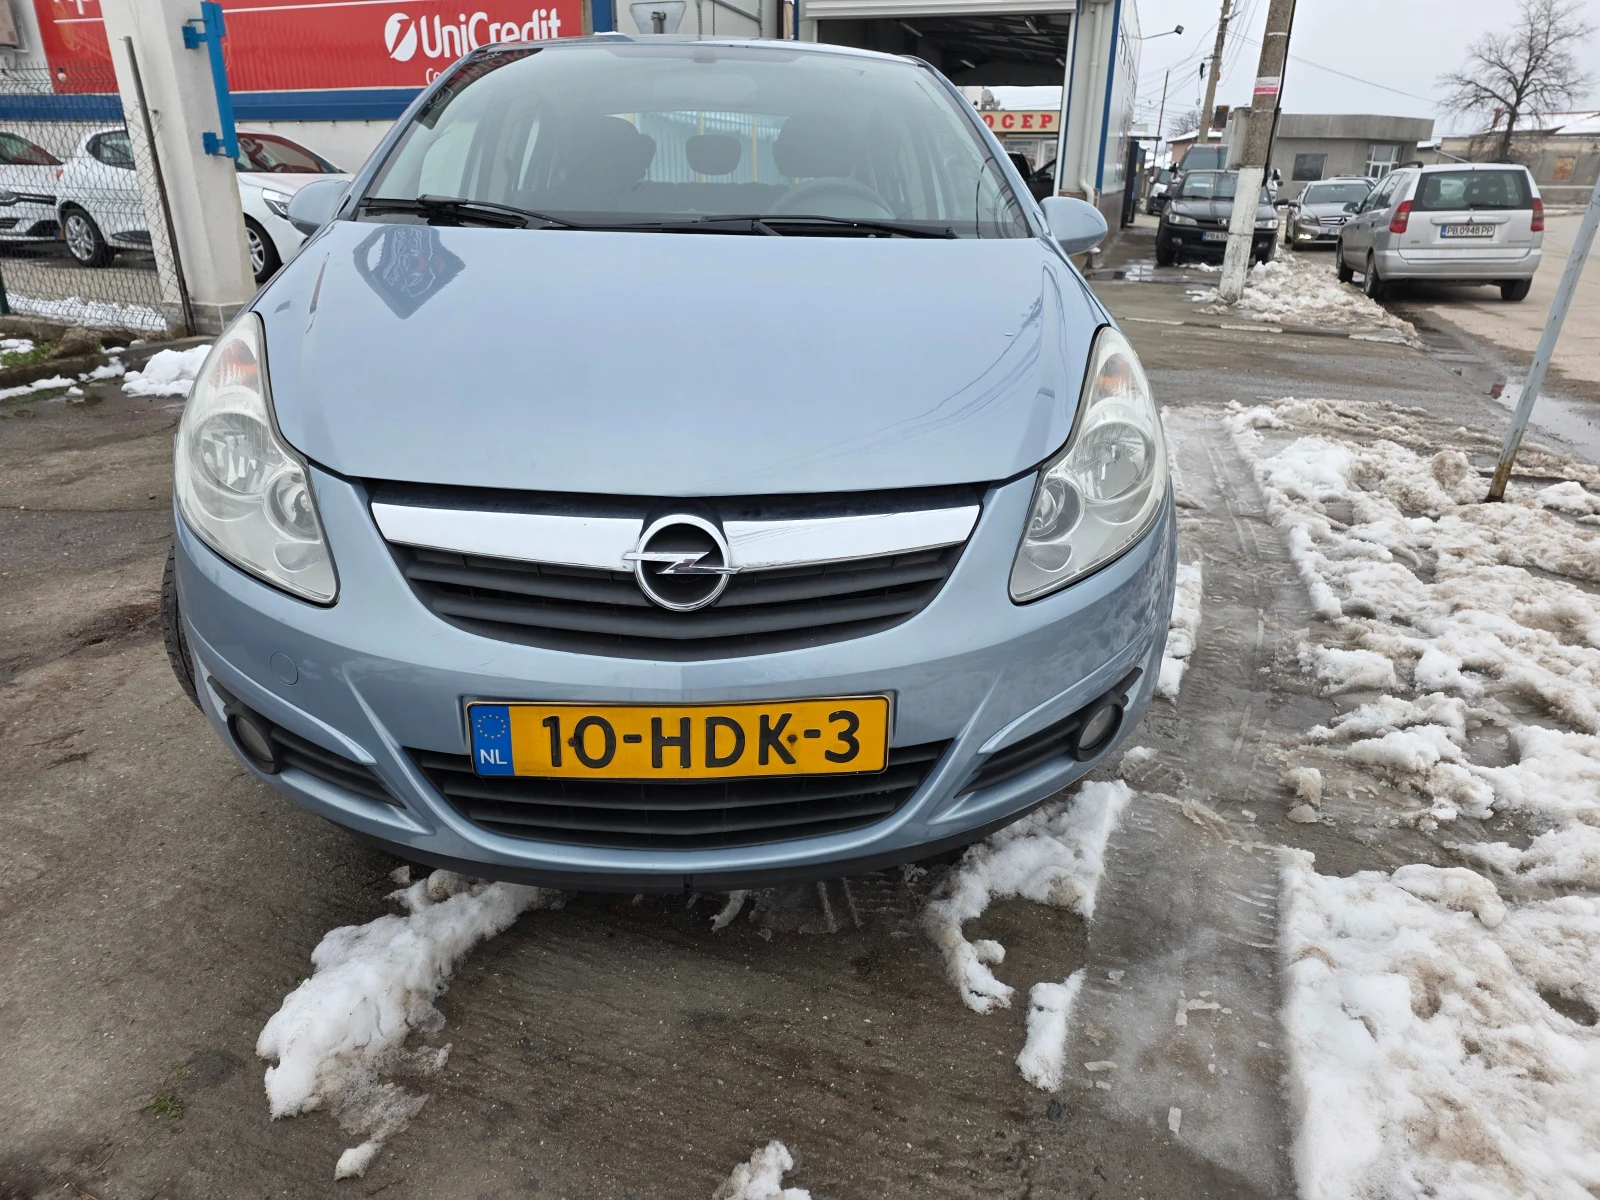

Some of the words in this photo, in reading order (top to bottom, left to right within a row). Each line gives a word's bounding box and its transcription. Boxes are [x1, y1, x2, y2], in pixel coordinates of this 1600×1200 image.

[420, 8, 562, 58] UniCredit
[480, 749, 507, 765] NL
[542, 710, 860, 769] 10-HDK-3
